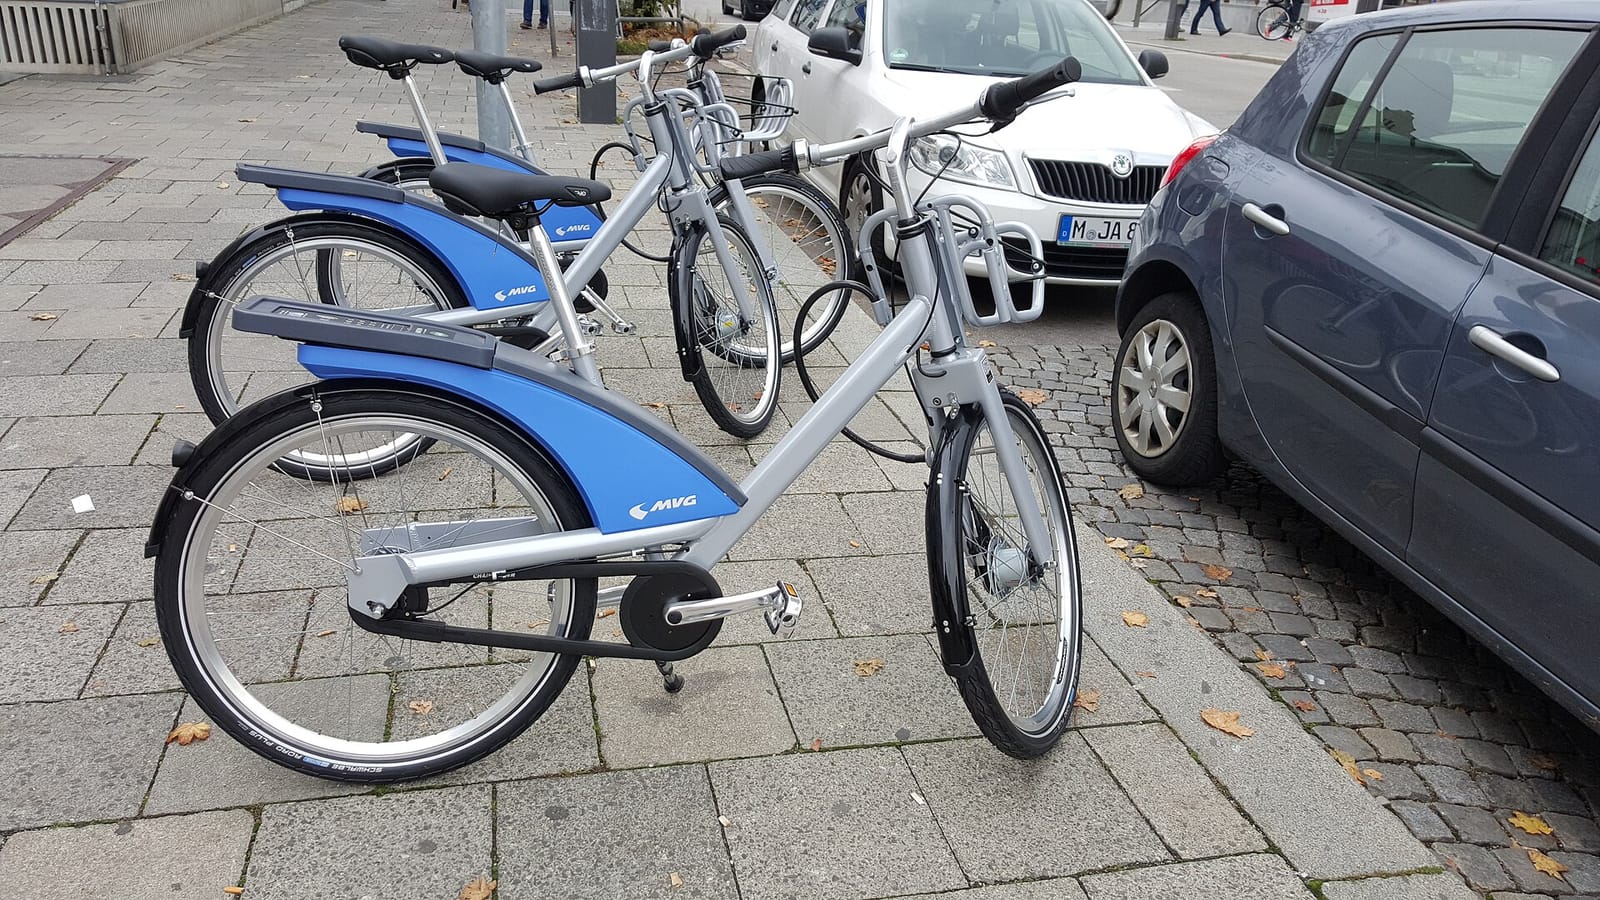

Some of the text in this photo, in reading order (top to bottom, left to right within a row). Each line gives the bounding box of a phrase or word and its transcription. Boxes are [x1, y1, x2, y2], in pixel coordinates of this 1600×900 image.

[567, 224, 590, 232] MVG
[1071, 220, 1087, 239] M
[1098, 221, 1121, 240] JA
[508, 285, 536, 297] MVG
[649, 494, 697, 512] MVG
[248, 730, 383, 773] SCHWALBE ROAD PLUS
